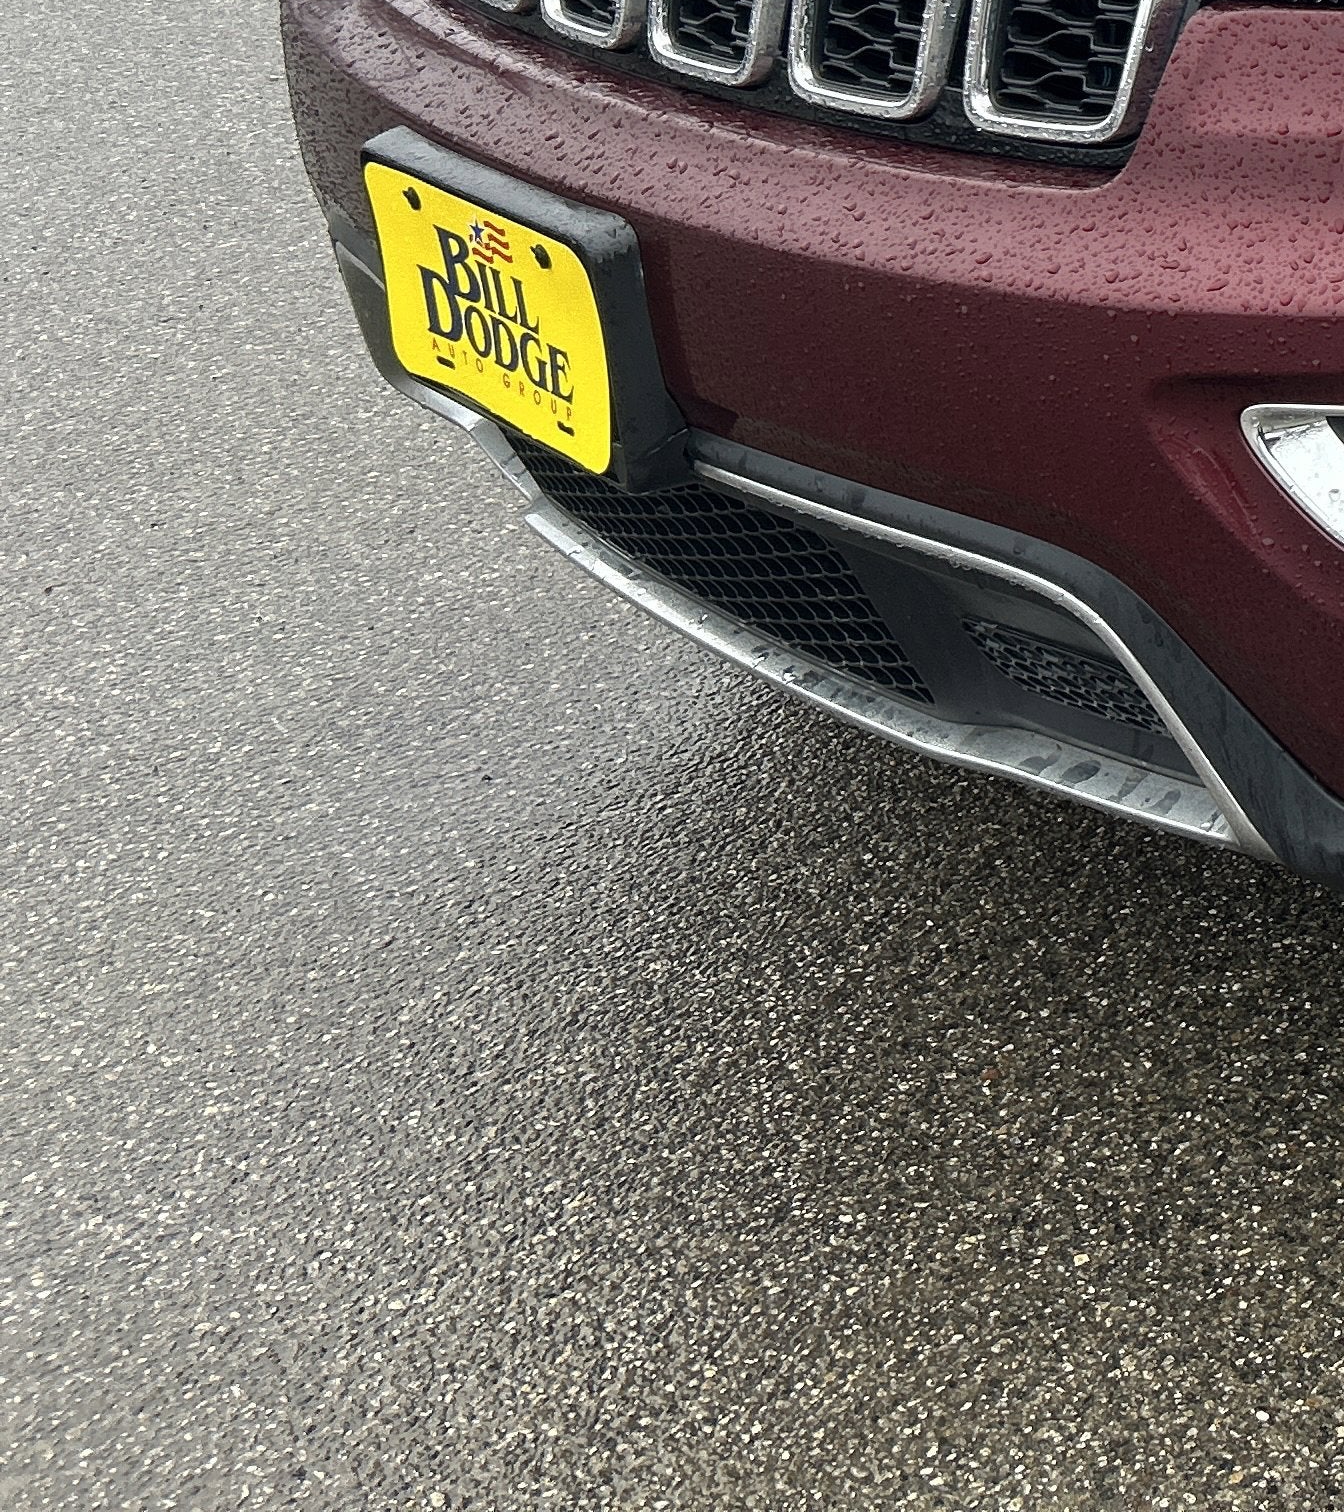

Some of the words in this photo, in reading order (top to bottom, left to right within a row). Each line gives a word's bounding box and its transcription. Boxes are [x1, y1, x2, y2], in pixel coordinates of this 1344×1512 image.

[416, 263, 575, 405] DODGE
[433, 224, 540, 335] BILL
[431, 337, 484, 374] AUTO
[502, 371, 573, 422] GROUP
